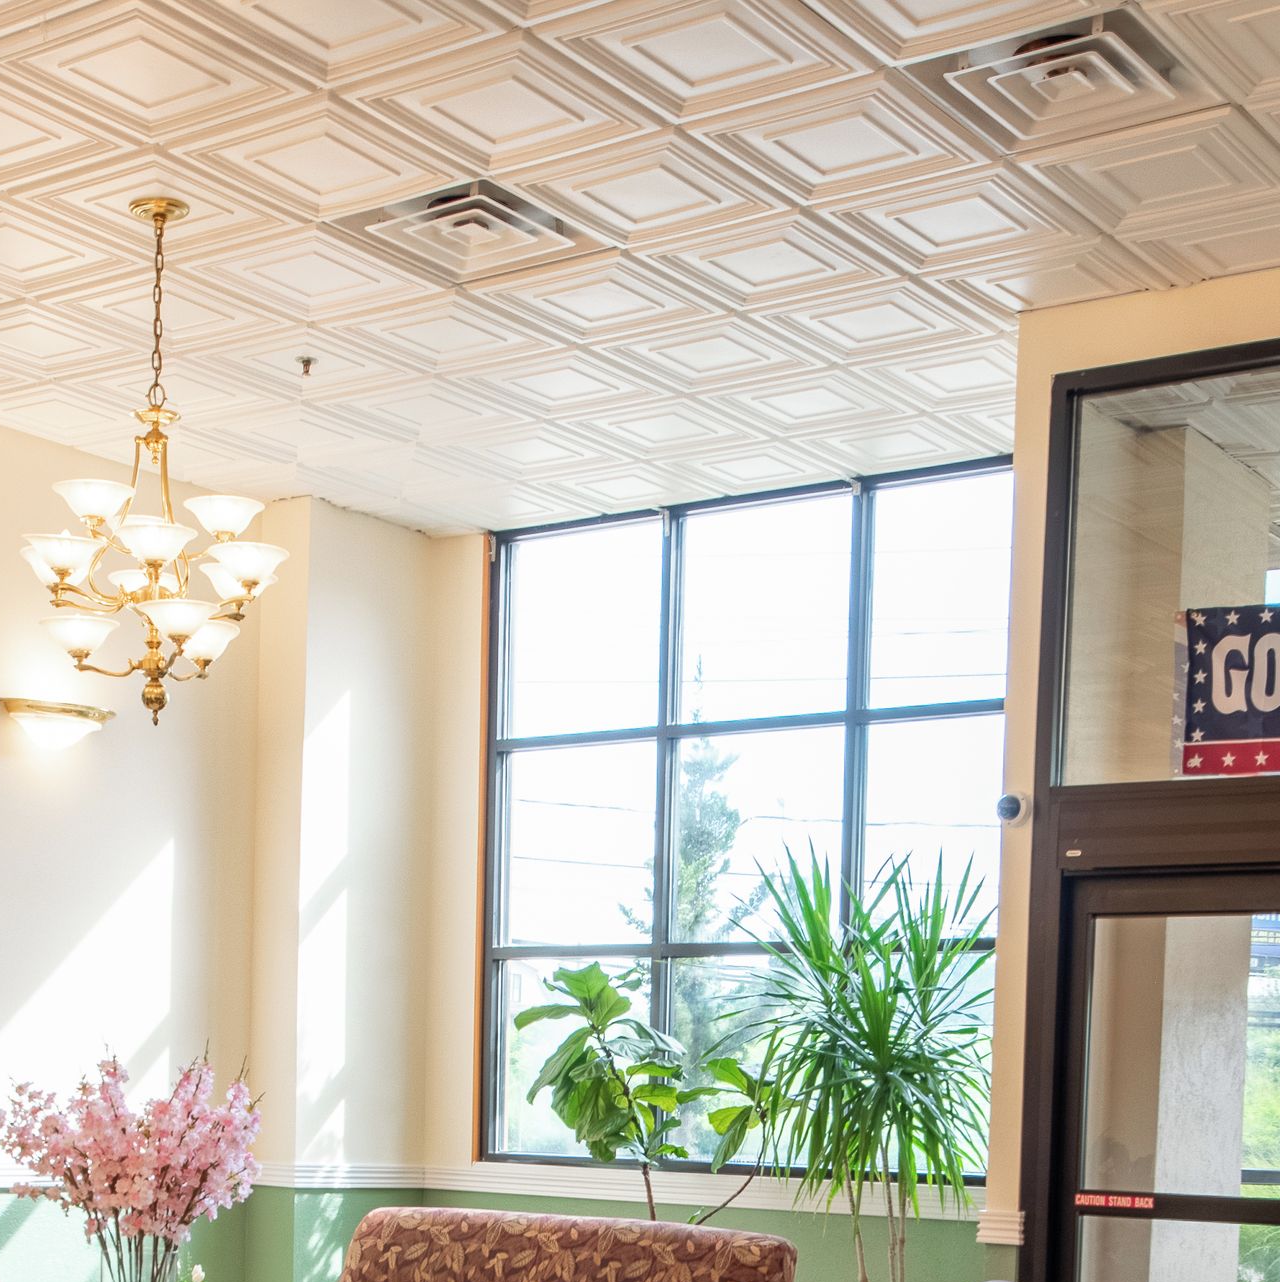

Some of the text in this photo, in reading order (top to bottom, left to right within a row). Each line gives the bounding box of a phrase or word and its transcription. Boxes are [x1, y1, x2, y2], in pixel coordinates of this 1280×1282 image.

[1075, 1194, 1154, 1209] CAUTION STAND BACK
